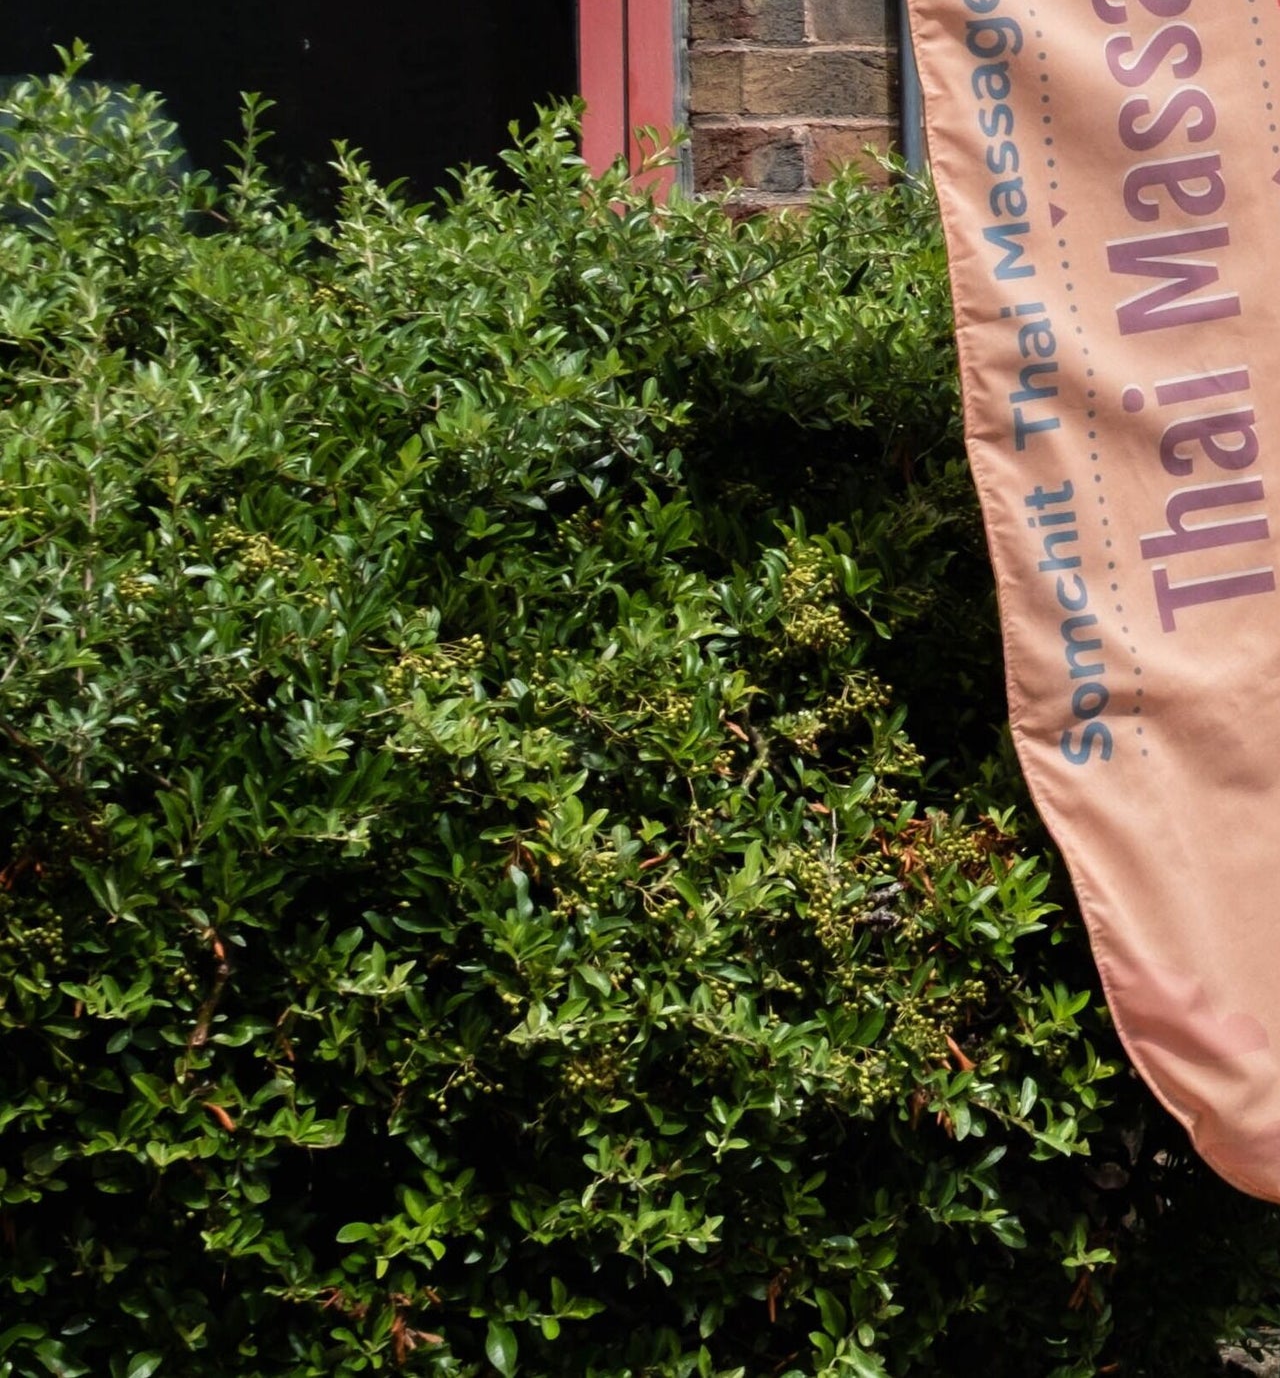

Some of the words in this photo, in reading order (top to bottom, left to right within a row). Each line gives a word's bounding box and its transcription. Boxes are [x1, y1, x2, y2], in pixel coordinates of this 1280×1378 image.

[1000, 302, 1061, 451] Thai
[1122, 364, 1276, 633] Thai
[1023, 478, 1113, 766] Somchit
